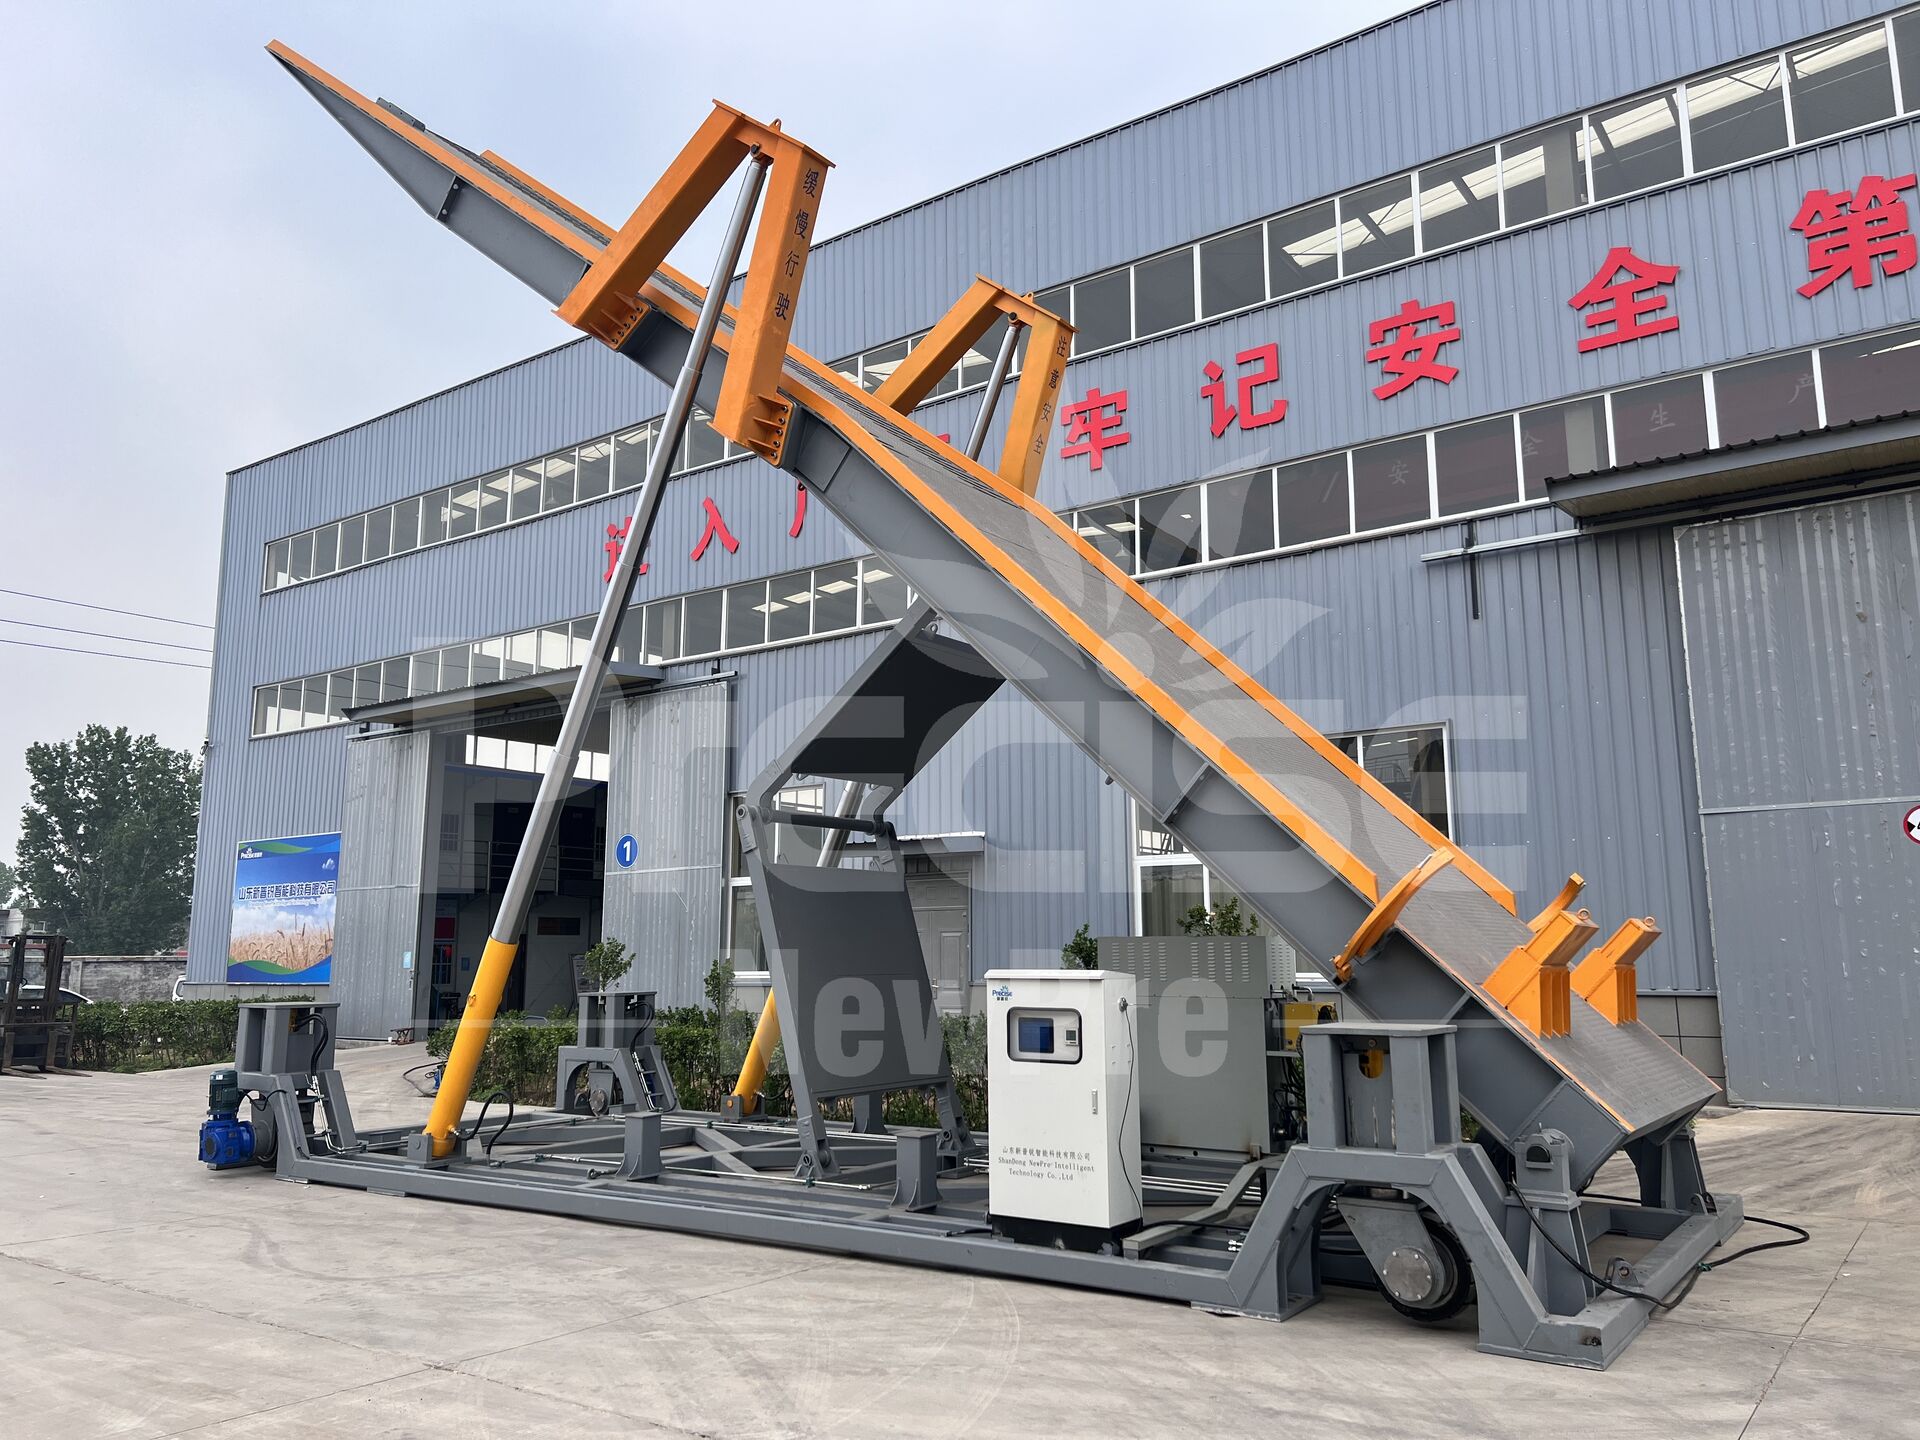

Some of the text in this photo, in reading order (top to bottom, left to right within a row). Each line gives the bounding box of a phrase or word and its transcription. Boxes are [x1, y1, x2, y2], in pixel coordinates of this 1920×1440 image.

[775, 168, 820, 321] 缓慢行驶
[623, 840, 632, 862] 1
[1009, 1168, 1044, 1179] Technology
[1054, 1161, 1095, 1172] Intelligent
